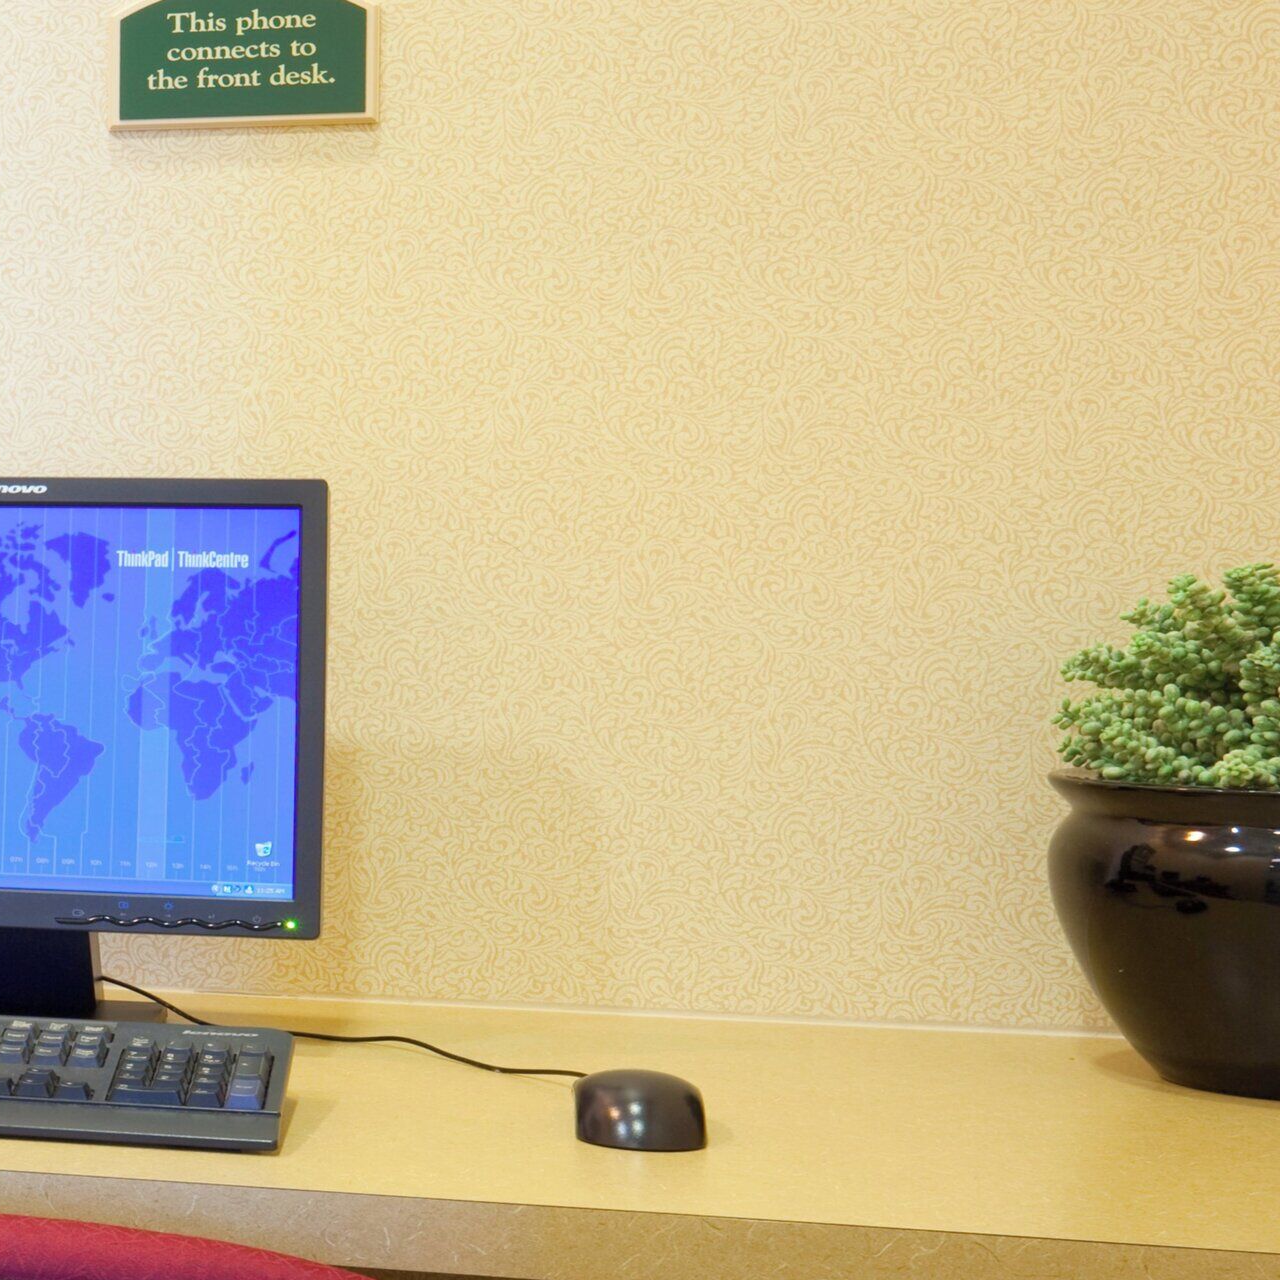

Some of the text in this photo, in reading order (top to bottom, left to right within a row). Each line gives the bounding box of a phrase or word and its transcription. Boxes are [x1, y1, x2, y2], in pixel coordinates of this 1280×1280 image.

[167, 9, 316, 36] This phone
[166, 40, 317, 62] connects to
[147, 63, 336, 90] the front desk.
[116, 550, 169, 568] ThinkPad
[178, 551, 249, 568] ThinkCentre
